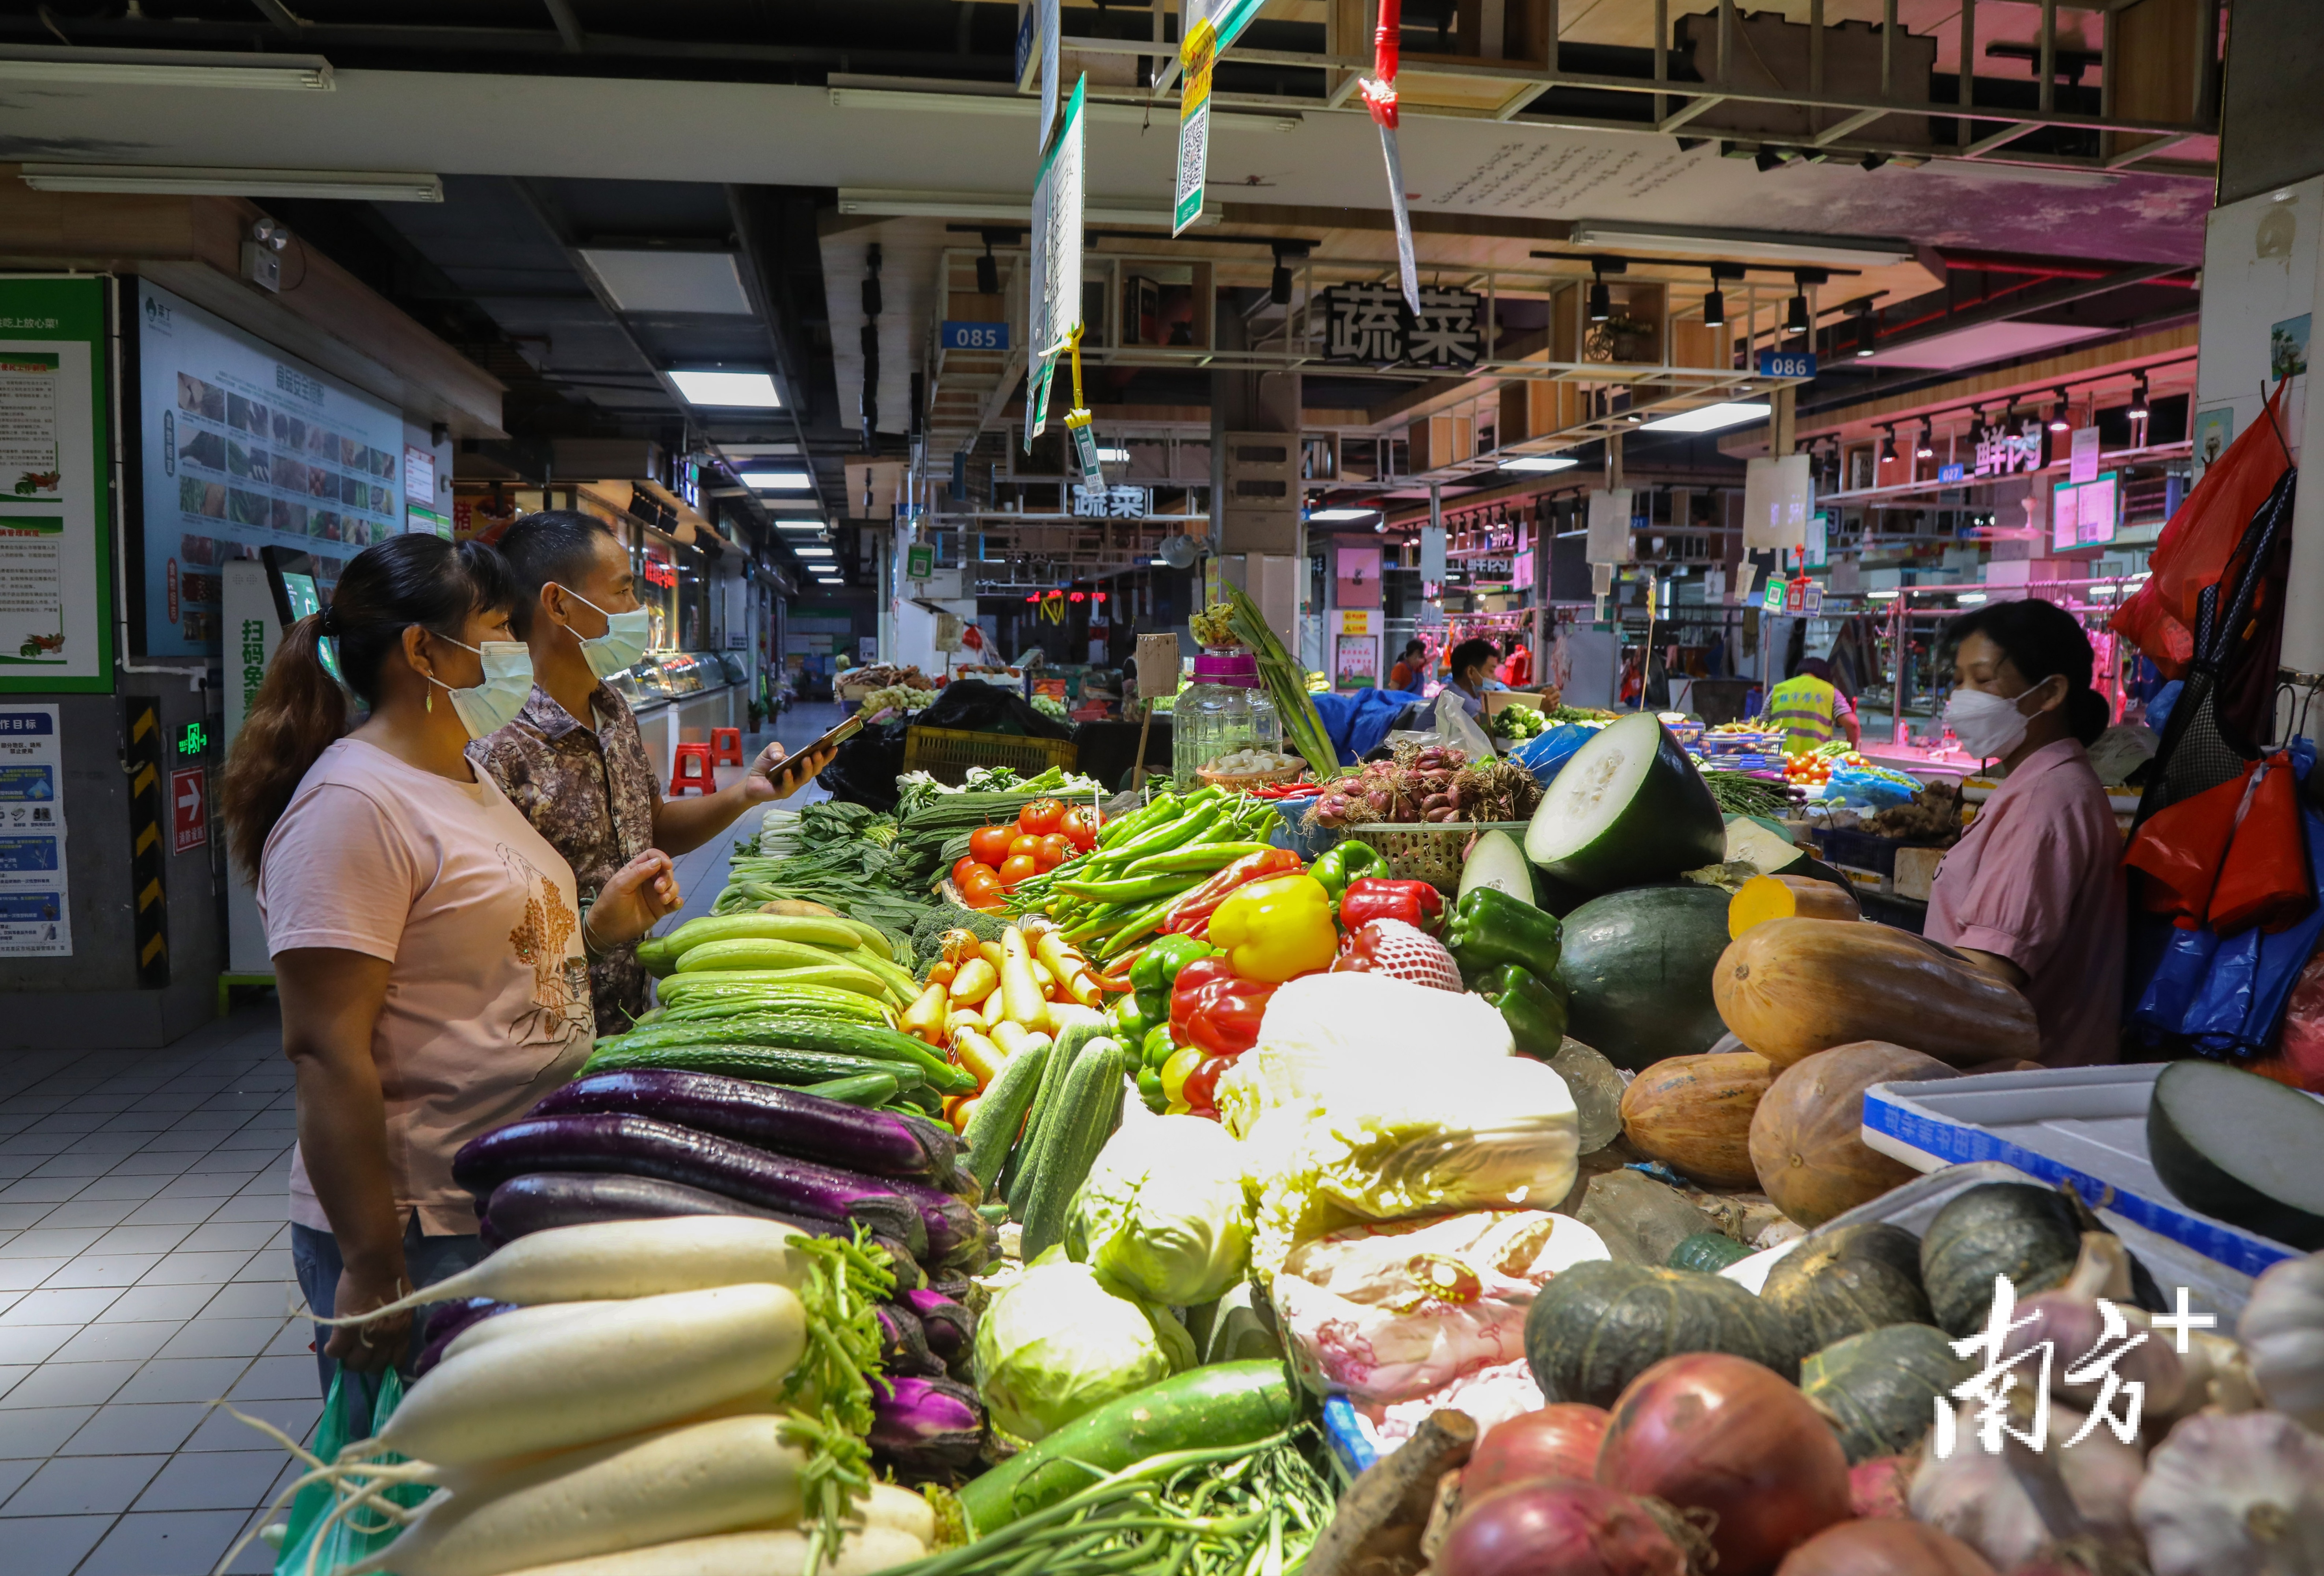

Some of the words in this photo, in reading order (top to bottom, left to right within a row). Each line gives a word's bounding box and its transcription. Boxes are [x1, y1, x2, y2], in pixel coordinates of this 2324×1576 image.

[1331, 284, 1478, 362] 蔬菜
[956, 329, 996, 347] 085
[0, 363, 46, 372] 便民工作制度
[1773, 359, 1807, 376] 086
[1975, 420, 2042, 475] 鲜肉
[1943, 468, 1959, 481] 027
[1072, 485, 1145, 518] 蔬菜
[0, 719, 36, 730] 作目标
[179, 826, 203, 846] 消防设施
